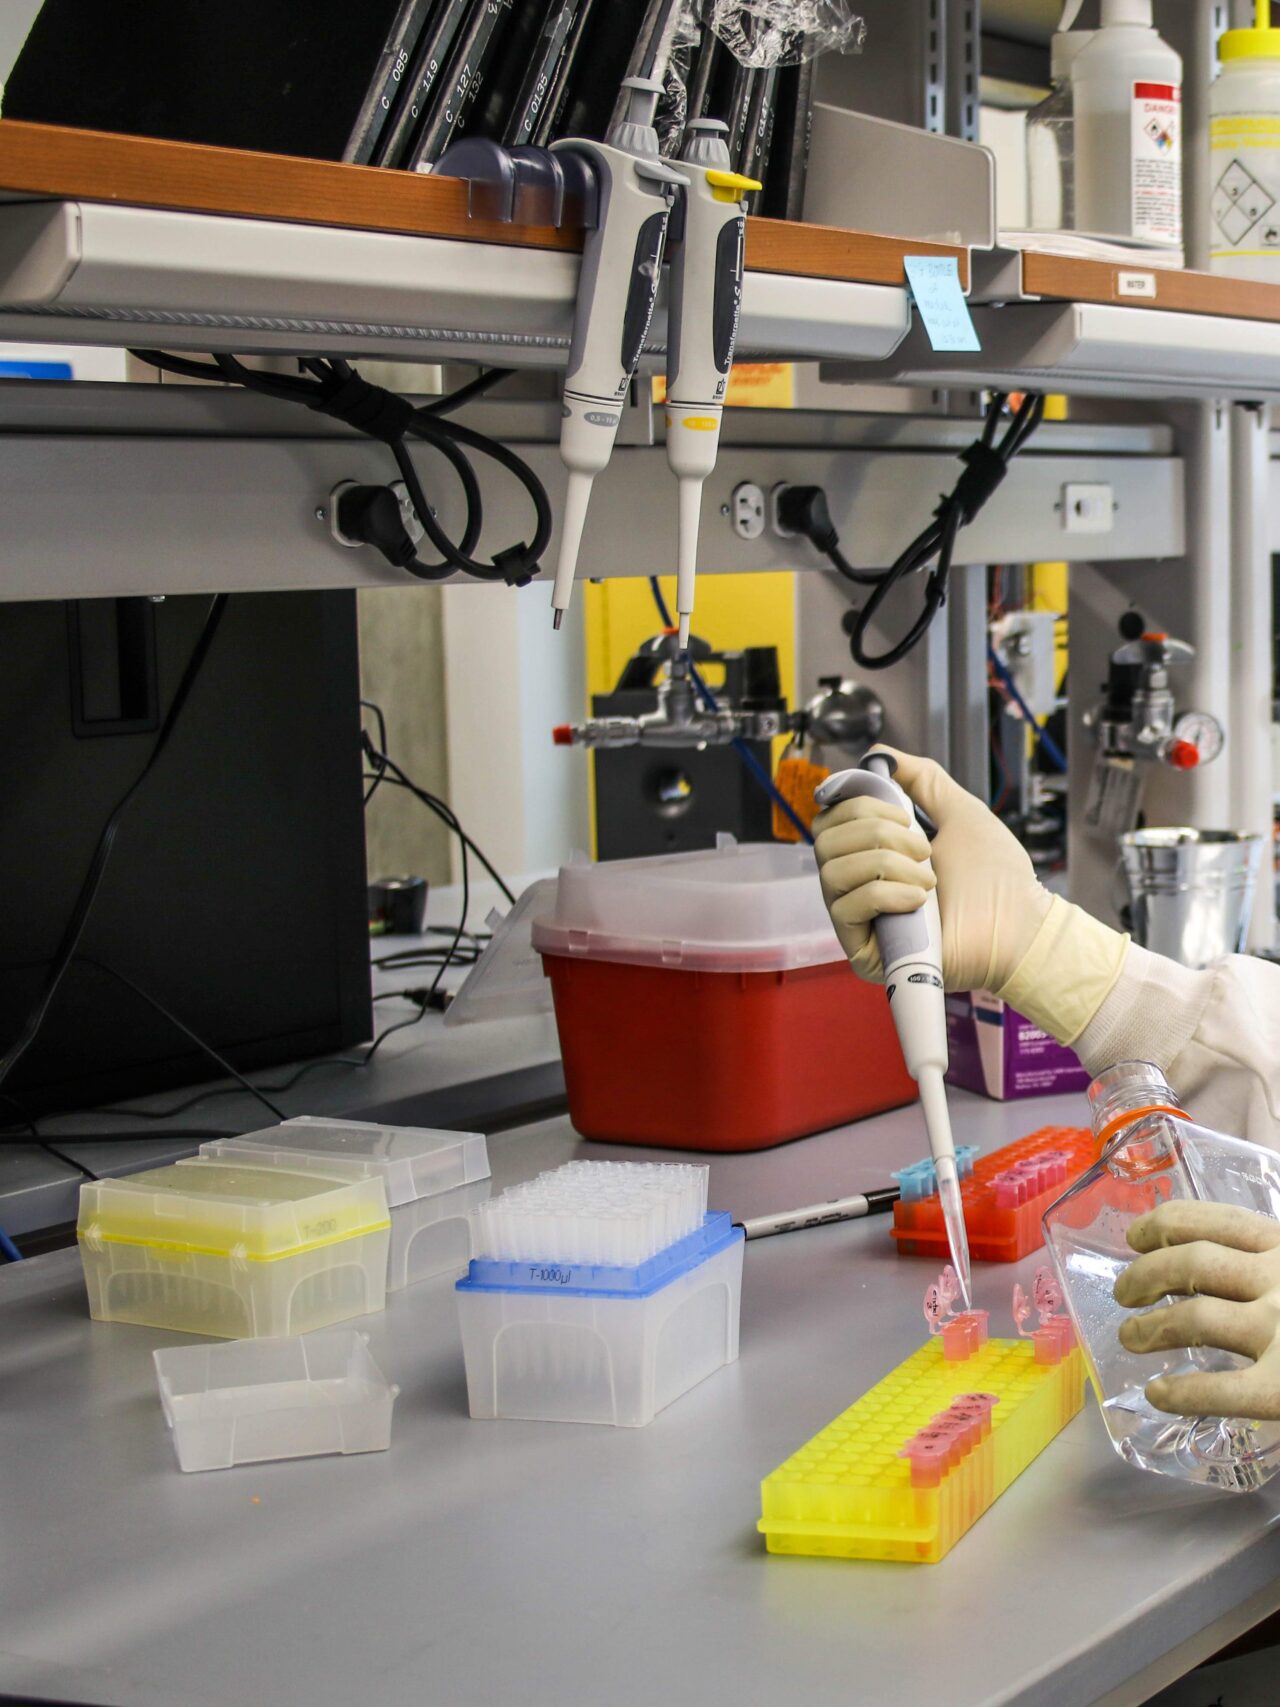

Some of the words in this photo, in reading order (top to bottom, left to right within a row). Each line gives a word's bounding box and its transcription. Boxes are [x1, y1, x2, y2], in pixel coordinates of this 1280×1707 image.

[381, 96, 390, 110] C
[392, 49, 409, 82] 085
[411, 105, 419, 118] C
[422, 59, 438, 92] 119
[445, 110, 454, 123] C
[456, 64, 472, 98] 127
[524, 119, 532, 132] C
[530, 73, 548, 113] 0135
